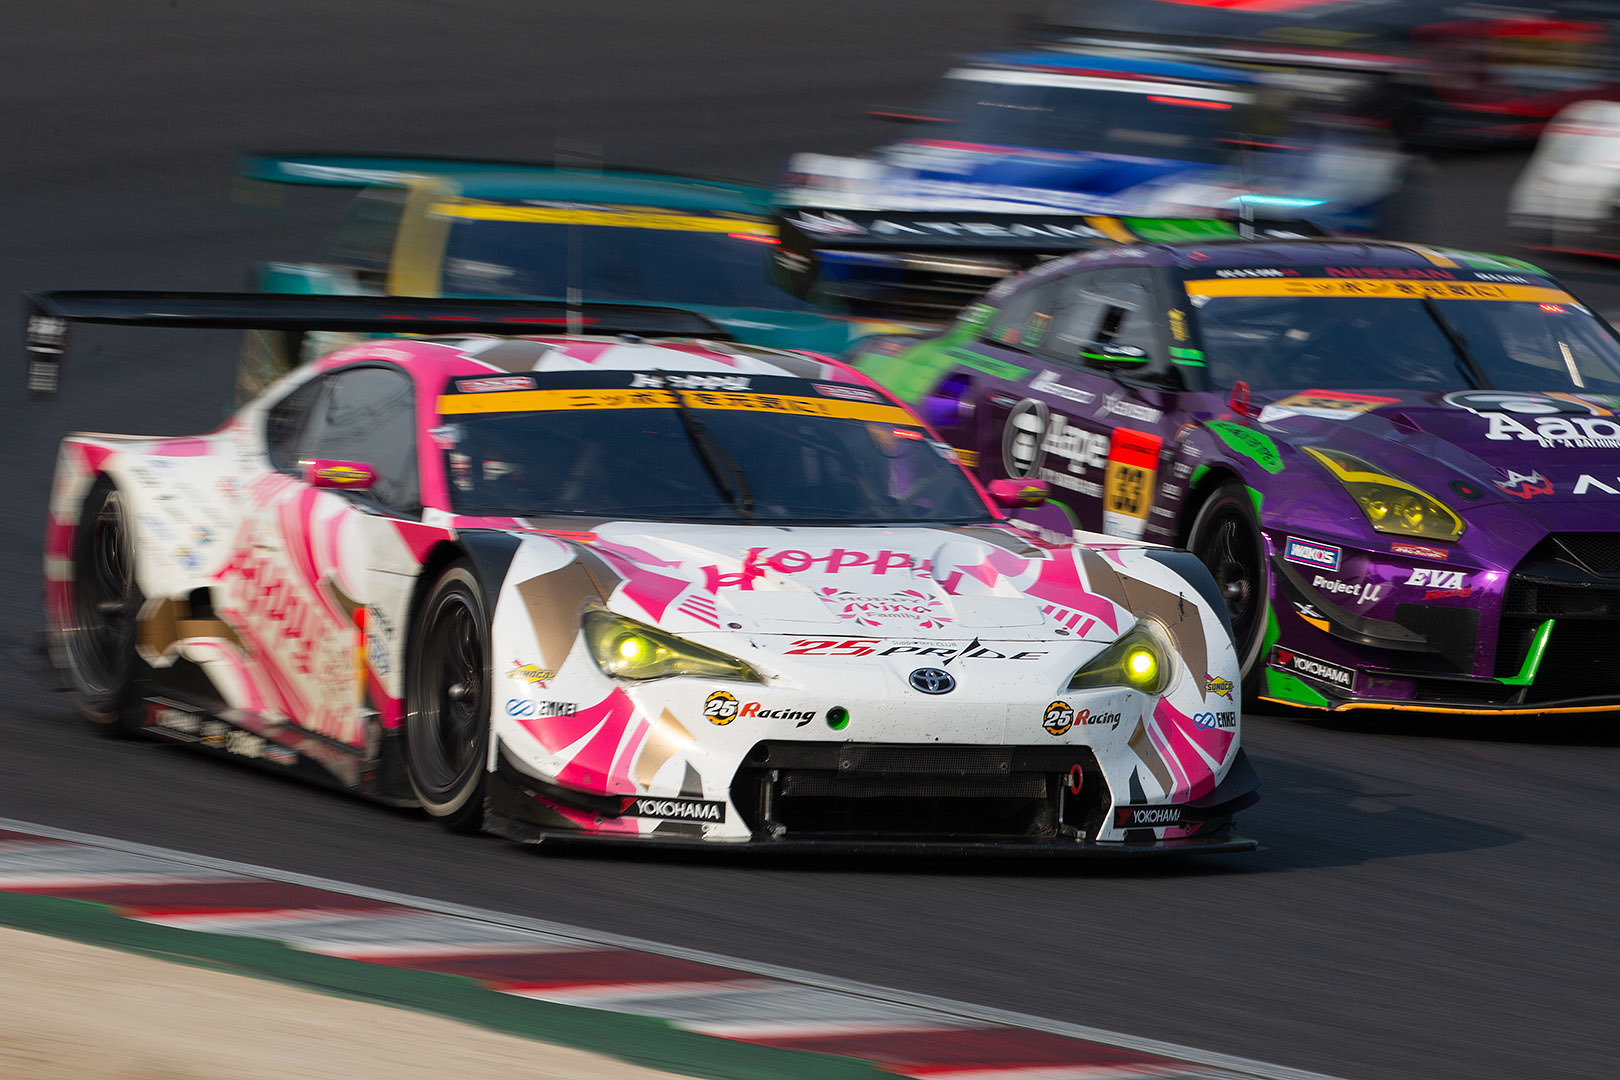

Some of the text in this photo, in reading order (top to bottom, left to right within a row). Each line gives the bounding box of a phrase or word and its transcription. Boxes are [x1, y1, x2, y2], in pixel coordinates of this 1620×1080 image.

[1323, 265, 1456, 281] NISSAN
[1312, 575, 1361, 596] Project
[1403, 568, 1468, 590] EVA
[843, 602, 932, 613] Mina
[1293, 656, 1350, 685] YOKOHAMA
[540, 700, 578, 718] ENKEI
[705, 700, 817, 728] 25 Racing
[1044, 709, 1121, 731] 25 Racing
[1216, 712, 1236, 728] ENKEI
[637, 800, 721, 820] YOKOHAMA
